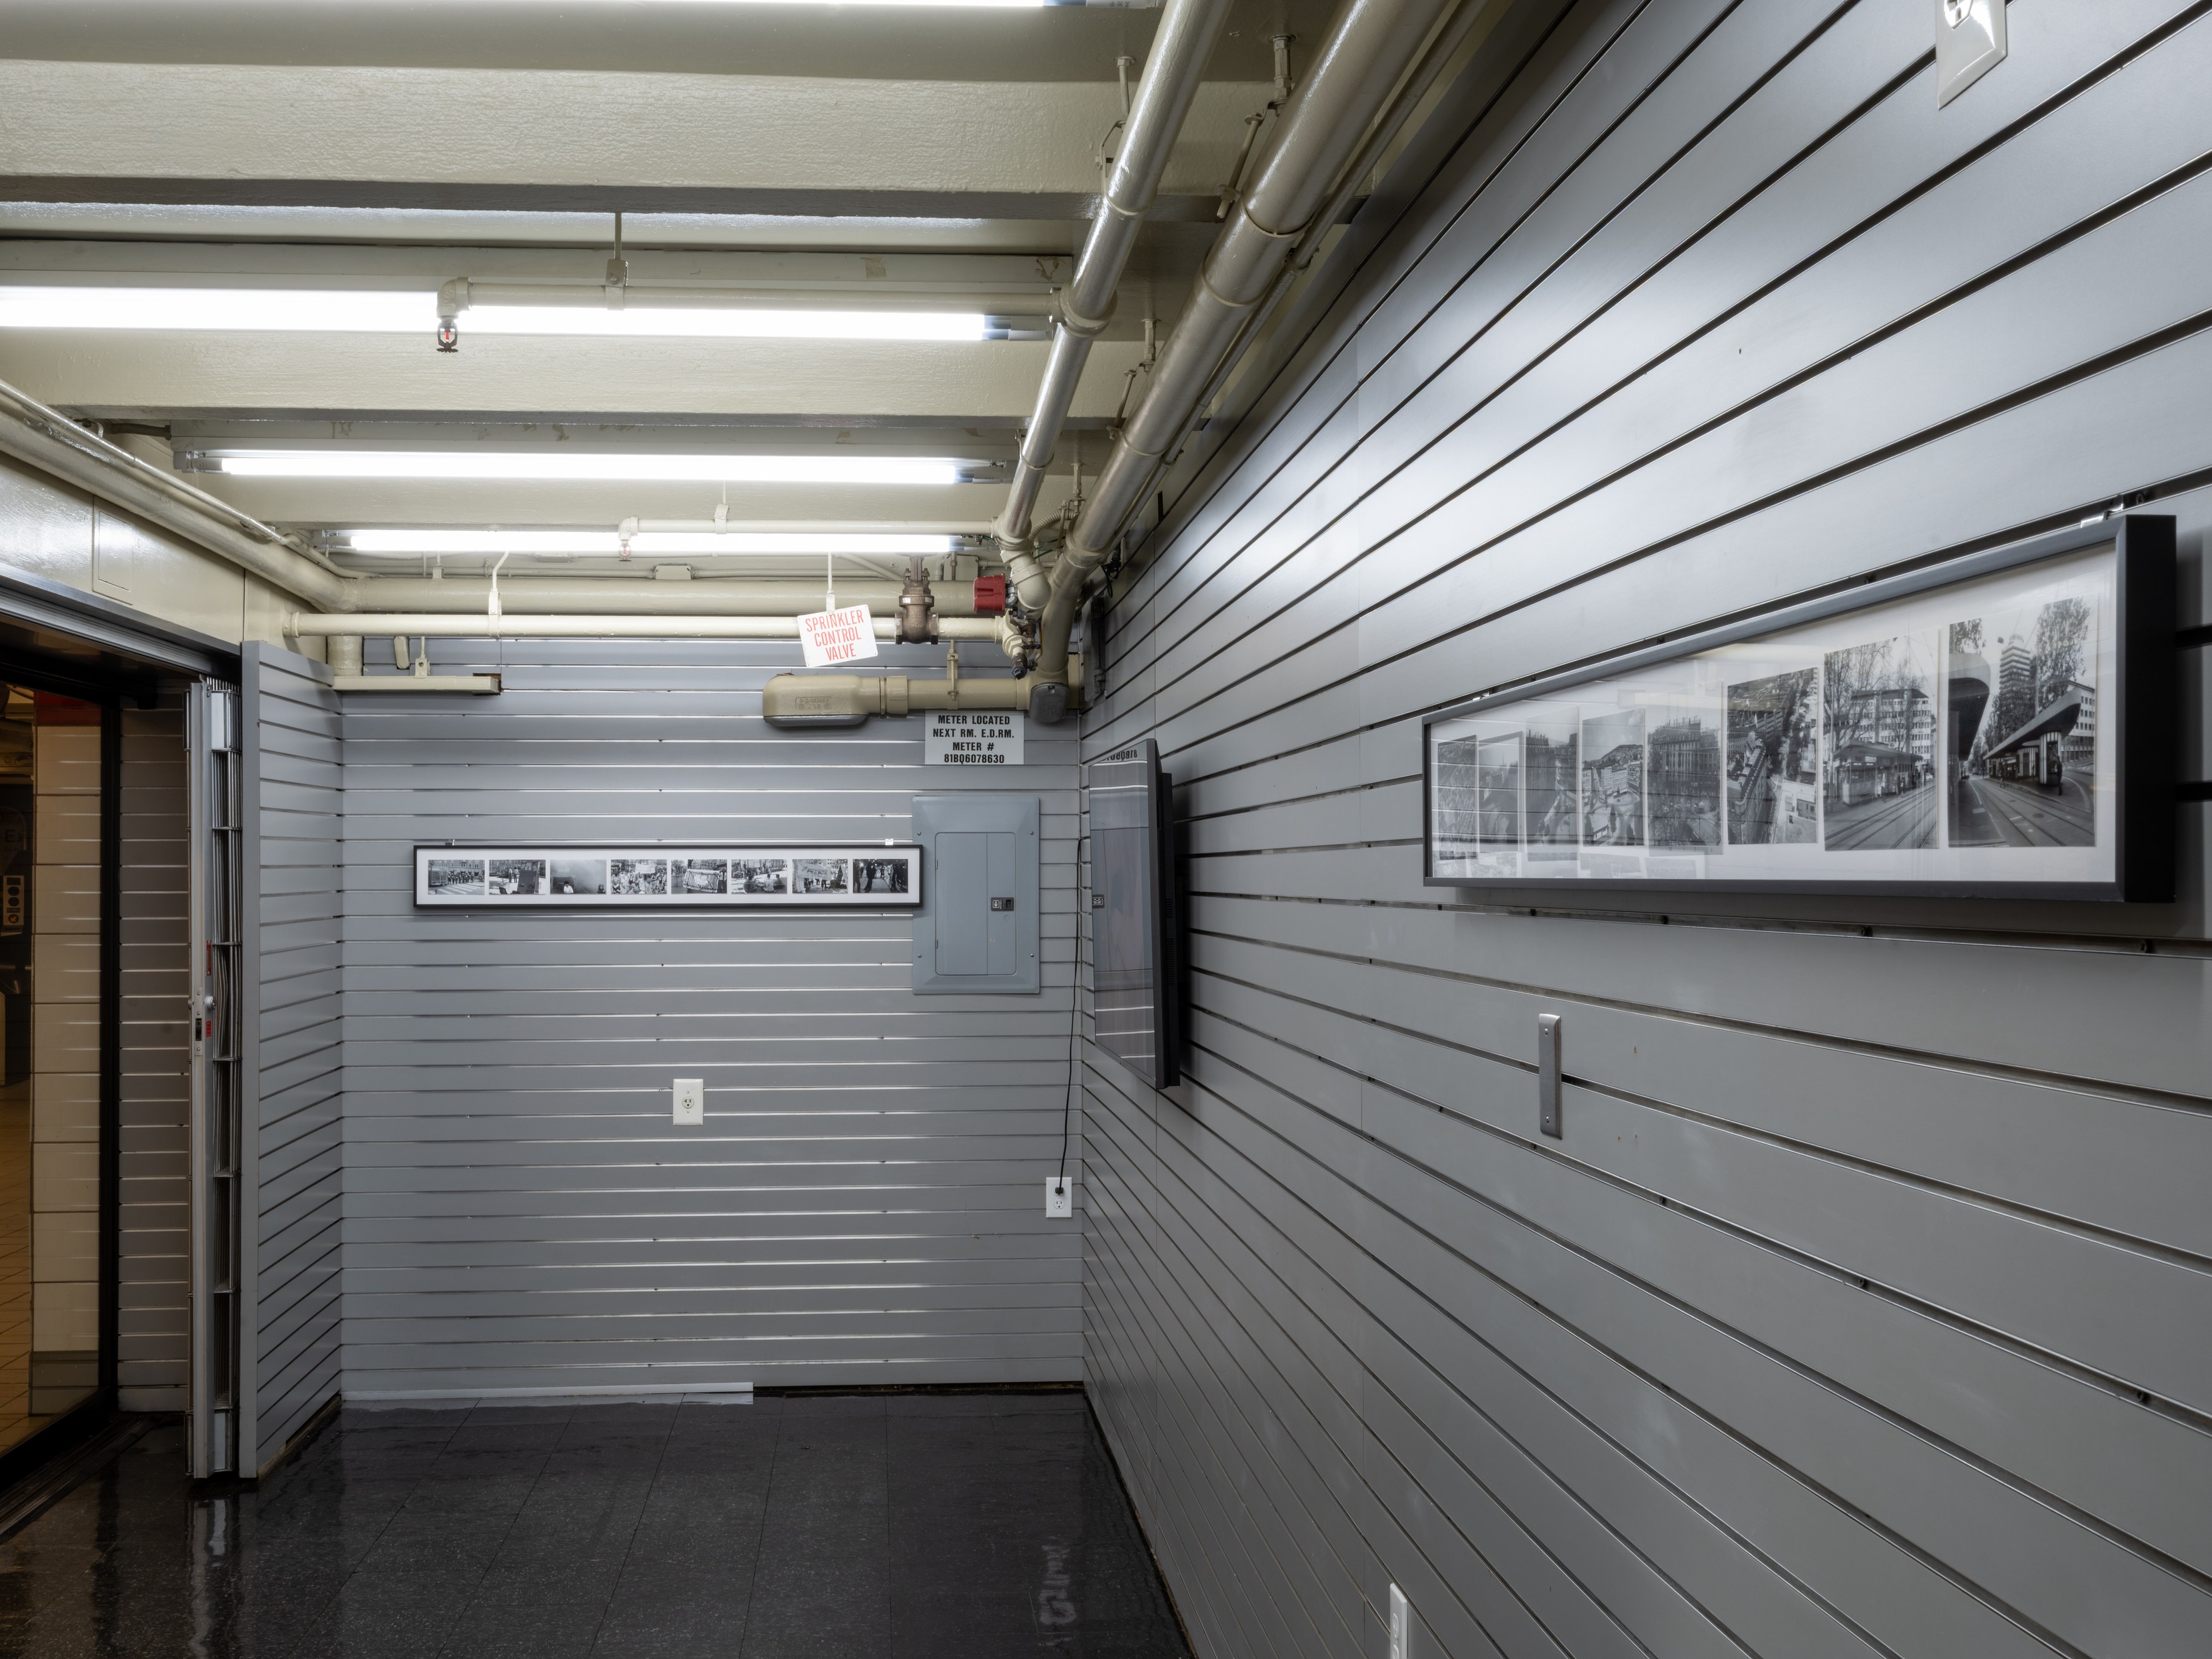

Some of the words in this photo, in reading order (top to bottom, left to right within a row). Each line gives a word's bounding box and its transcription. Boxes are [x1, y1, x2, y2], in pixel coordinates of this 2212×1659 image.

[805, 609, 864, 632] SPRINKLER
[814, 626, 861, 647] CONTROL
[825, 643, 856, 660] VALVE
[938, 715, 967, 724] METER
[971, 715, 1010, 725] LOCATED
[932, 728, 956, 738] NEXT
[961, 729, 976, 738] RM.
[981, 729, 1014, 738] E.D.RM.
[952, 742, 981, 751] METER
[987, 743, 994, 751] #
[944, 754, 1004, 764] 81BQ6078630
